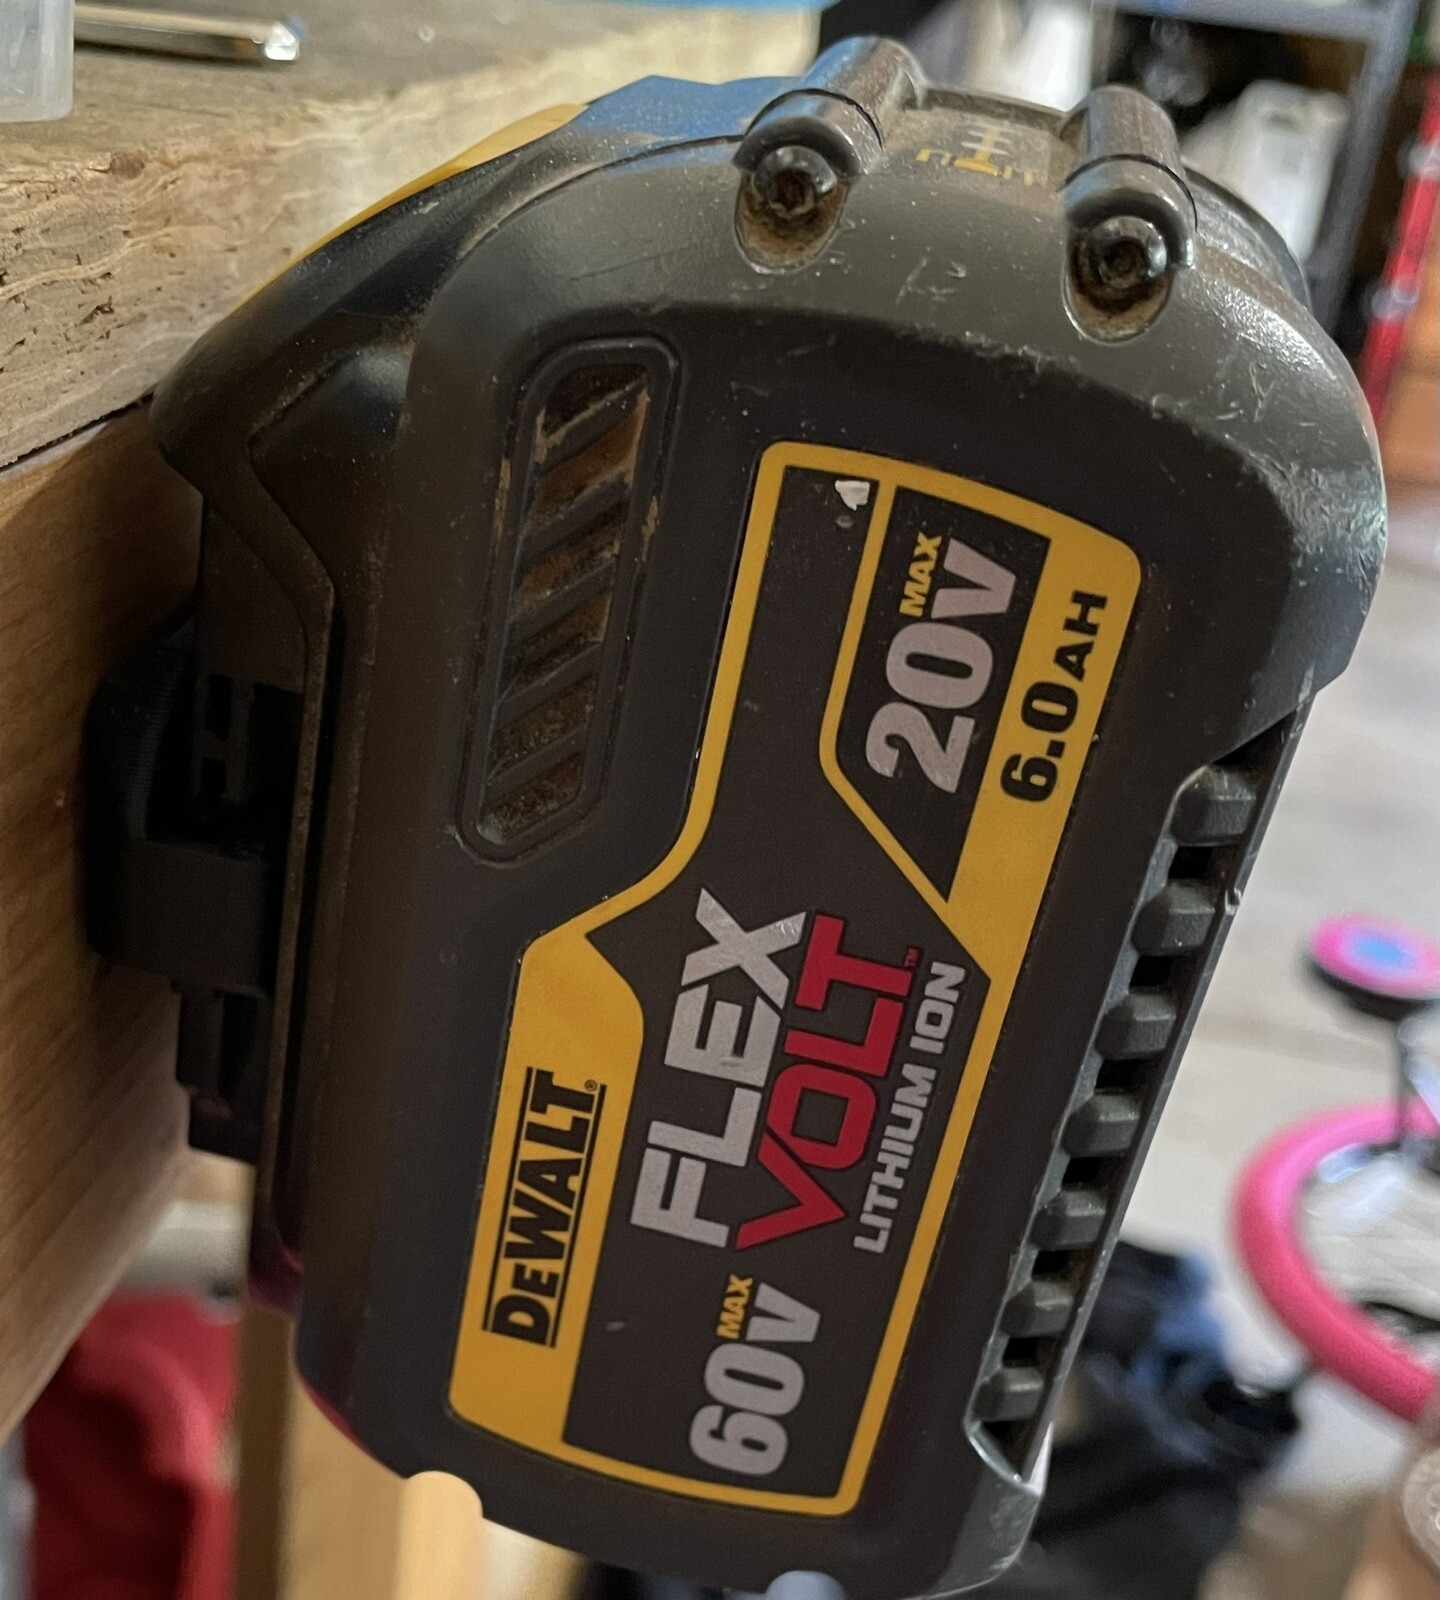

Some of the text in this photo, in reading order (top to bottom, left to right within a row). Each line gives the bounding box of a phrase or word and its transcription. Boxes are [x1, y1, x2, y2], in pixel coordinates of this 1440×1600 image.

[865, 537, 1016, 793] 20V
[899, 531, 942, 618] MAX
[630, 888, 806, 1248] FLEX
[735, 914, 914, 1250] VOLT
[853, 961, 966, 1253] LITHIUM ION
[491, 1068, 596, 1347] DEWALT
[716, 1273, 753, 1340] MAX
[689, 1282, 821, 1476] 60V
